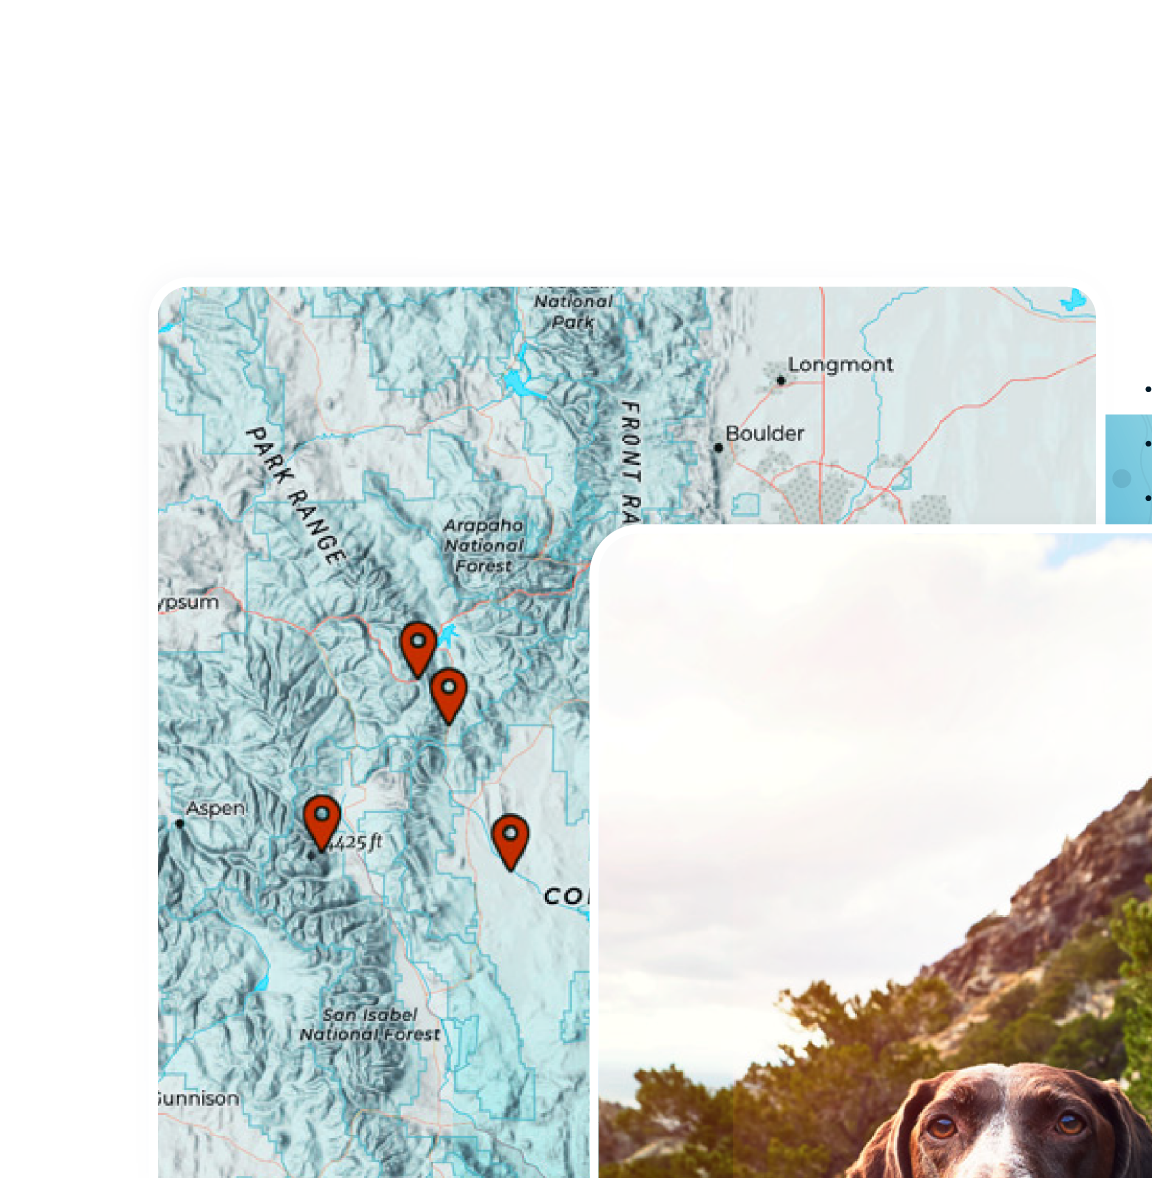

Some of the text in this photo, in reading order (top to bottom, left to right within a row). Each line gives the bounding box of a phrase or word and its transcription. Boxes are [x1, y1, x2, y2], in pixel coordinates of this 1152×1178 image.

[534, 294, 613, 308] National
[551, 315, 595, 330] Park
[788, 356, 894, 376] Longmont
[726, 425, 805, 441] Boulder
[621, 400, 641, 483] FRONT
[245, 426, 347, 565] PARK RANGE
[444, 538, 525, 552] National
[455, 560, 512, 573] Forest
[186, 801, 245, 819] Aspen
[367, 832, 383, 854] ft
[322, 1006, 418, 1021] San Isabel
[299, 1028, 441, 1041] National Forest
[158, 1089, 240, 1106] unnison
